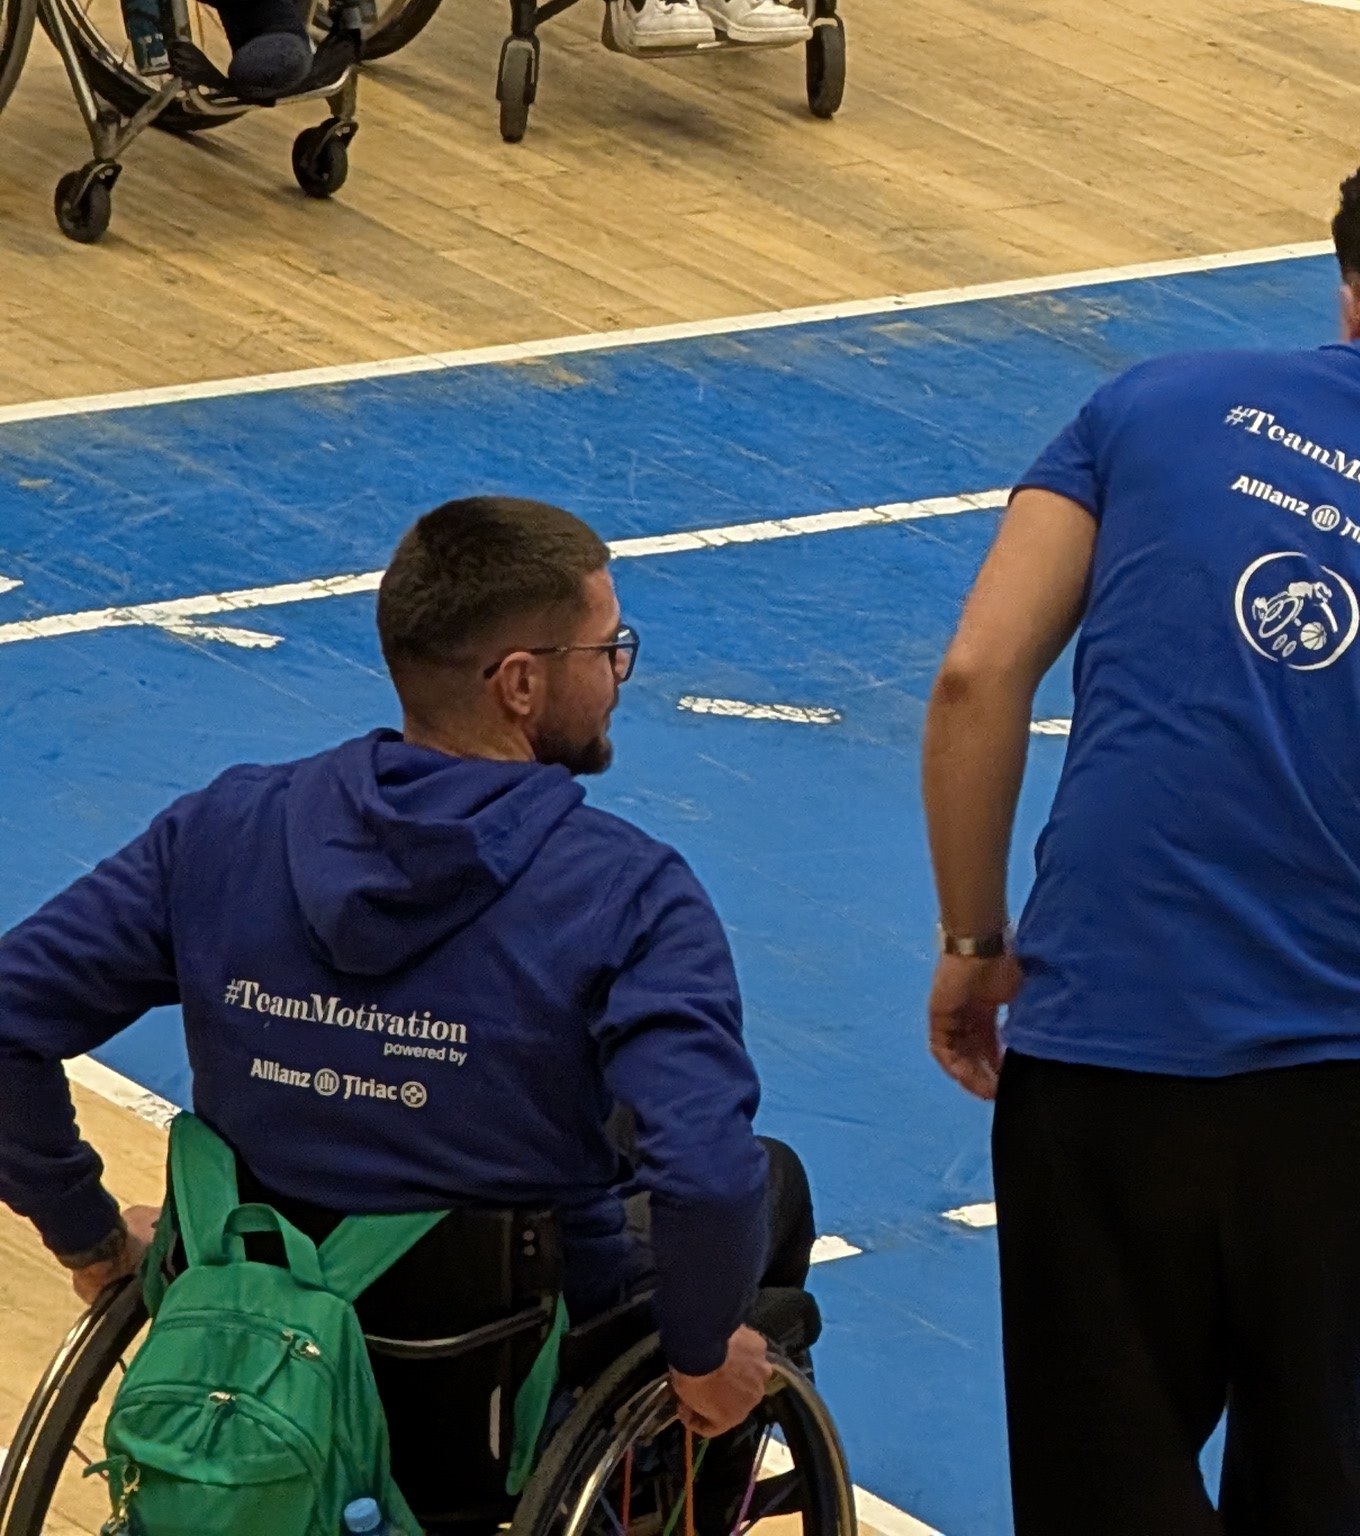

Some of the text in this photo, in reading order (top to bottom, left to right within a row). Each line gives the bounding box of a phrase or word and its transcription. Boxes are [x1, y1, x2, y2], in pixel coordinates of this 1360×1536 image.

[1231, 474, 1310, 517] Allianz
[224, 978, 469, 1044] #TeamMotivation
[383, 1041, 468, 1066] powered by
[250, 1058, 311, 1088] Allianz
